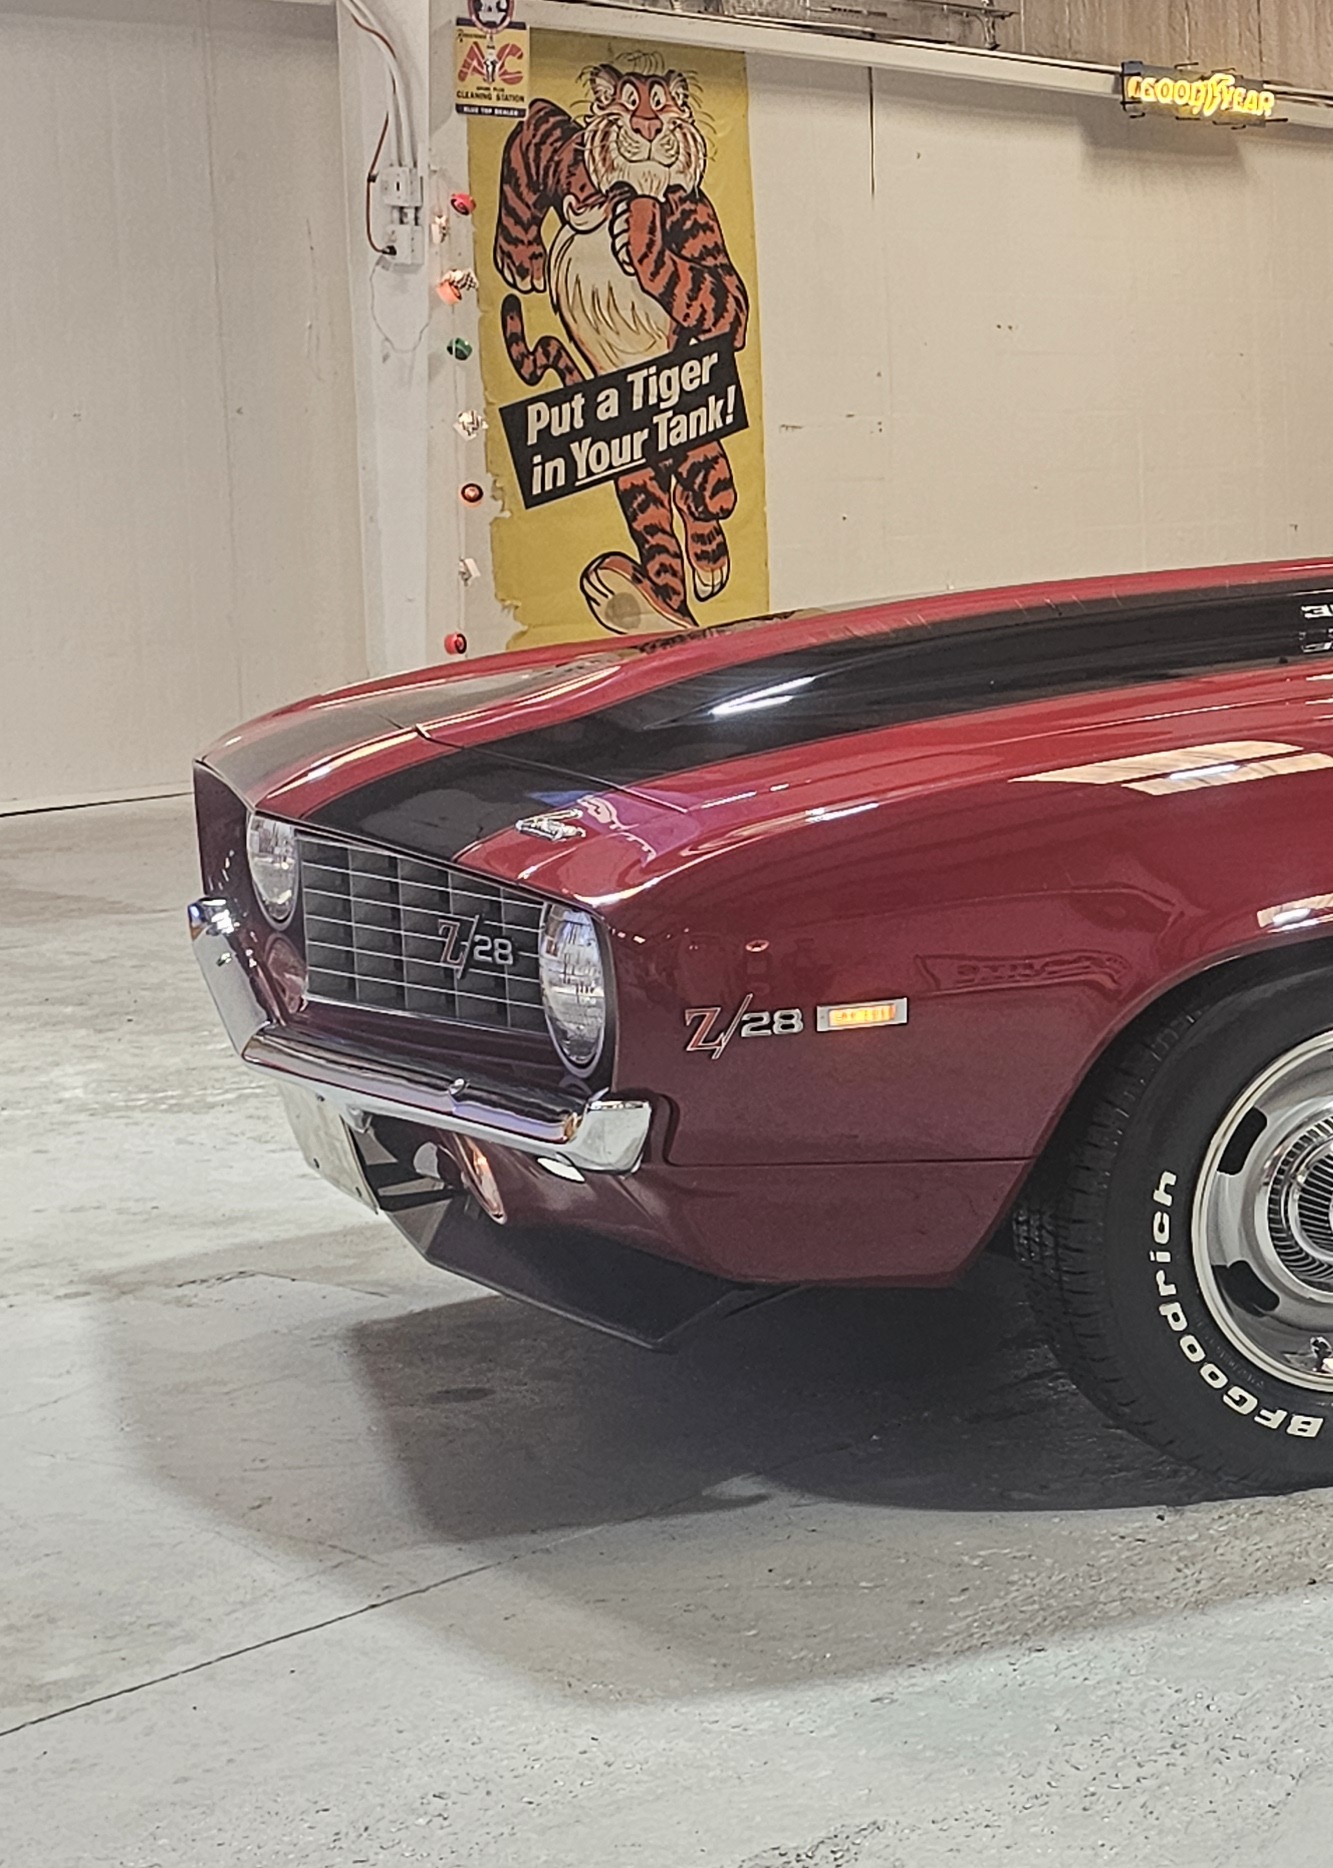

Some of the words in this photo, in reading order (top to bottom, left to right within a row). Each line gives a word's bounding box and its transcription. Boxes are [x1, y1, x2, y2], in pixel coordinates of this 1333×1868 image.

[1138, 73, 1276, 117] GOODYEAR
[527, 392, 585, 446] Put
[597, 387, 619, 421] a
[627, 352, 719, 412] Tiger
[532, 455, 565, 496] in
[570, 428, 650, 484] Your
[653, 385, 737, 452] Tank!
[438, 914, 514, 980] Z/28
[684, 993, 804, 1060] Z/28
[1150, 1170, 1325, 1439] BFGoodrich
